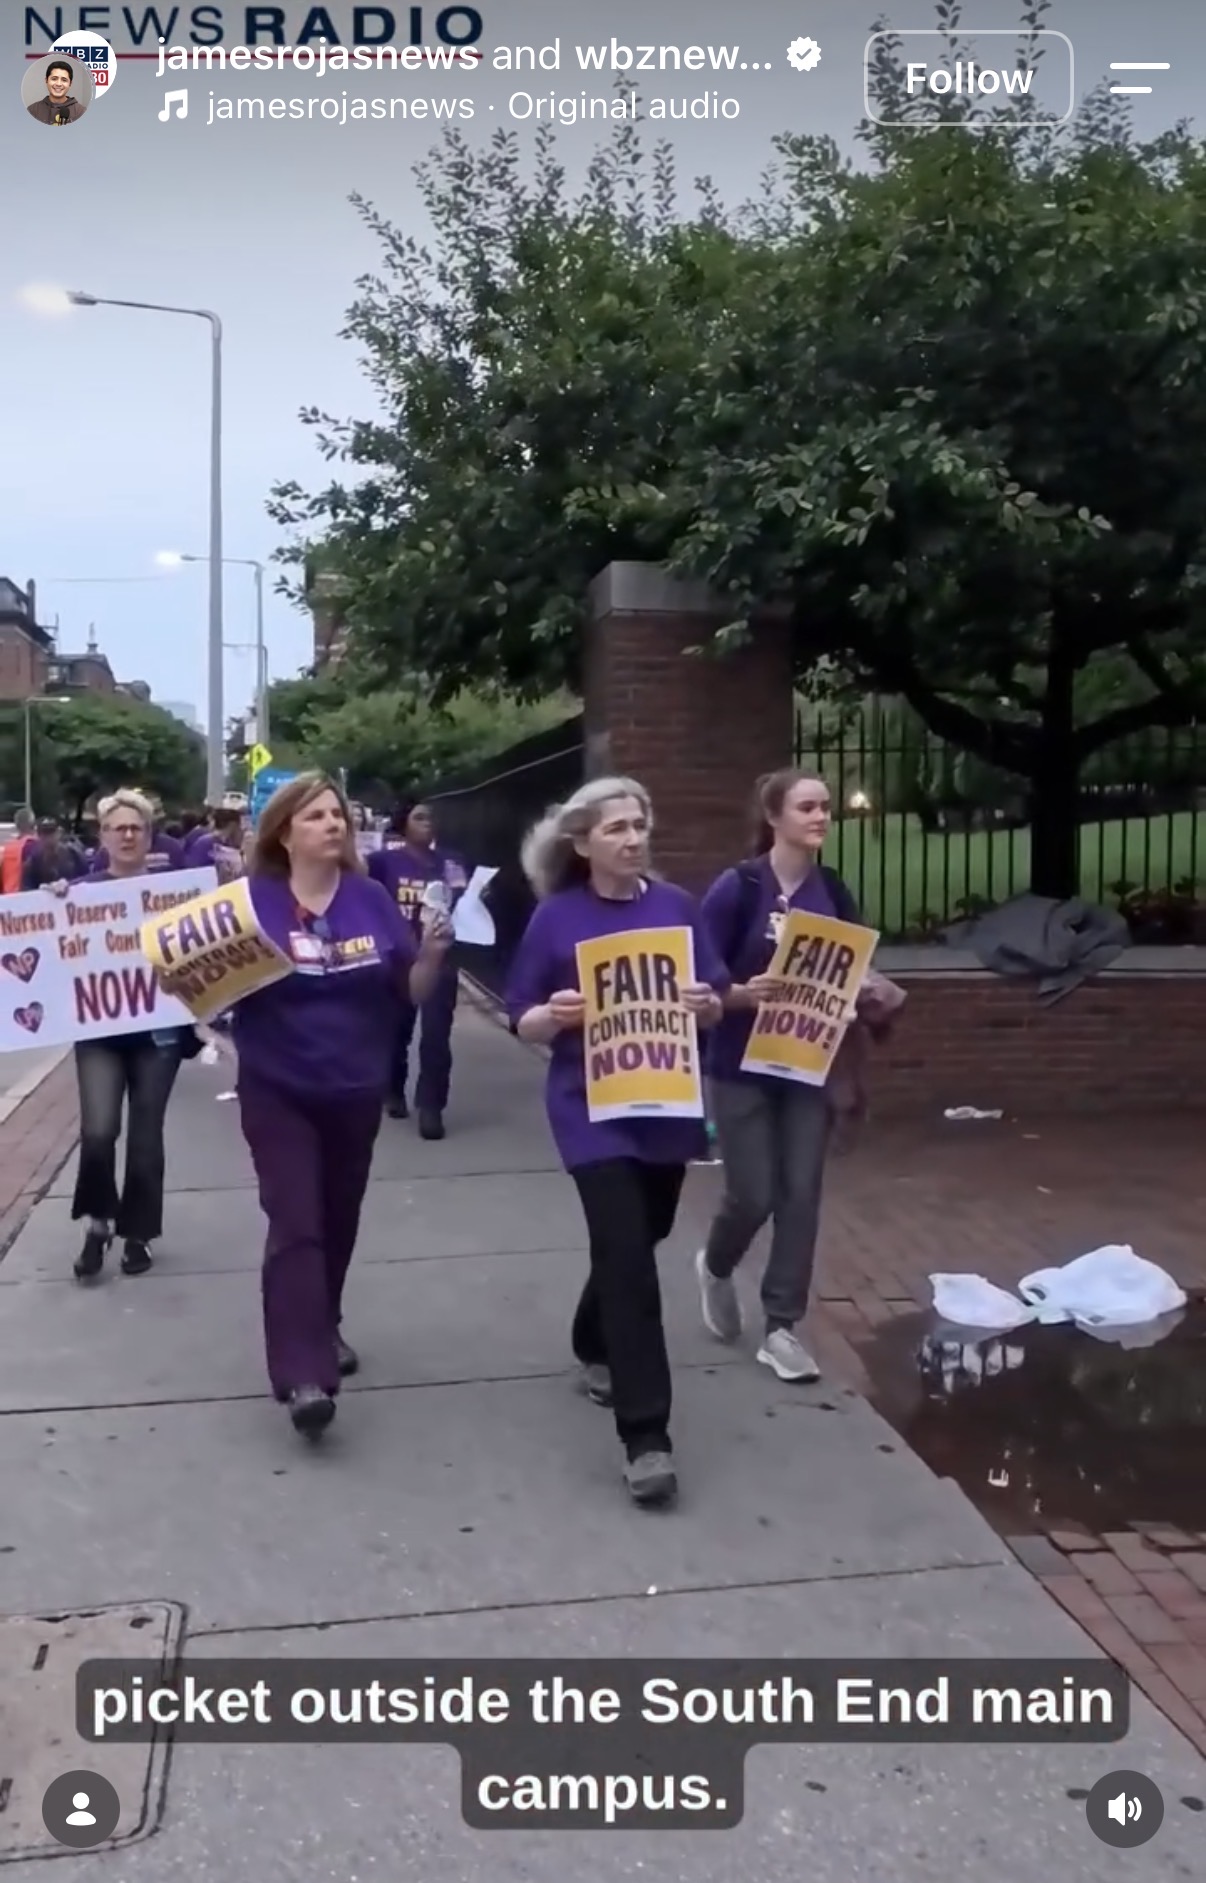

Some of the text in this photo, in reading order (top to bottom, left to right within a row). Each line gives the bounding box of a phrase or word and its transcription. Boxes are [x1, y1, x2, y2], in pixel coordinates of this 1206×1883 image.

[0, 911, 55, 936] Nurses
[66, 902, 128, 926] Deserve
[157, 900, 243, 965] FAIR
[58, 928, 141, 959] Fair Cont
[176, 935, 268, 977] ONTRACT
[782, 934, 856, 990] FAIR
[74, 967, 159, 1024] NOW
[593, 953, 680, 1012] FAIR
[588, 1008, 690, 1047] CONTRACT
[757, 1009, 838, 1050] NOW!
[591, 1041, 692, 1081] NOW!
